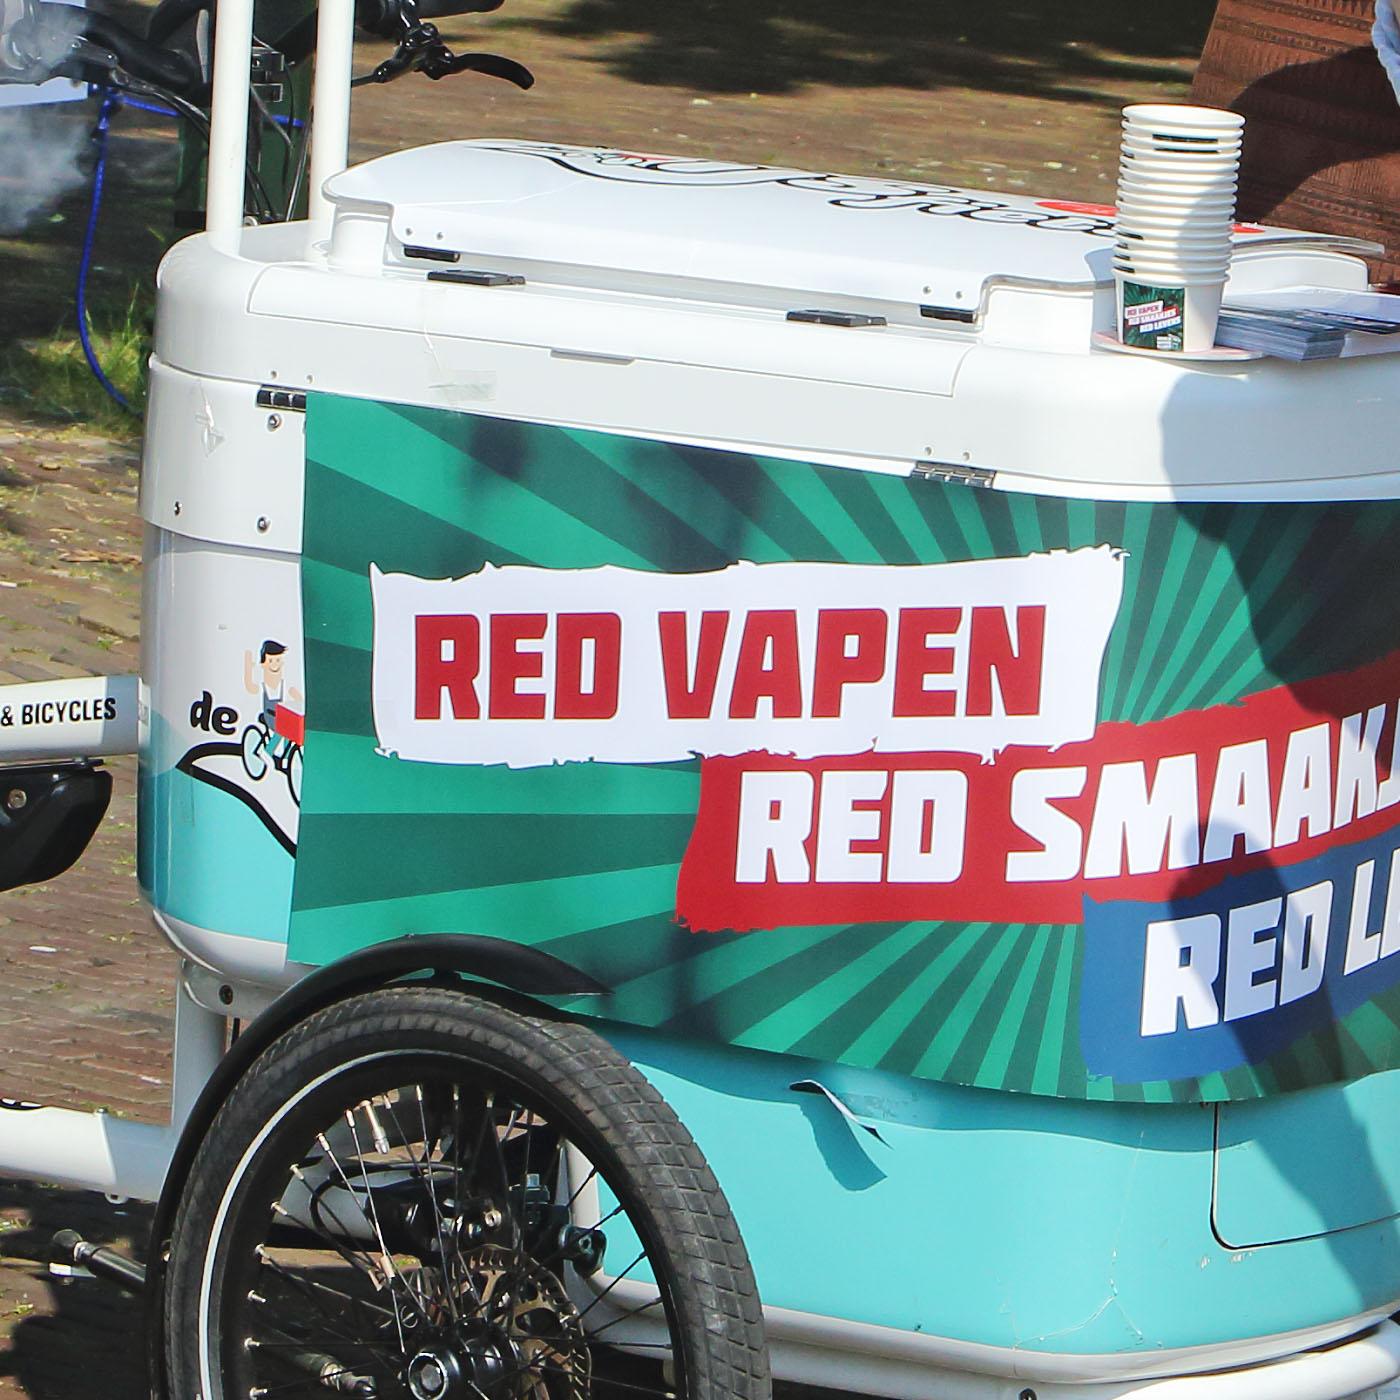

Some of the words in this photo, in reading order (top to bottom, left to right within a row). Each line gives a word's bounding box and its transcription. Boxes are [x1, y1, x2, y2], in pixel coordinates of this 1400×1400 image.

[0, 705, 14, 727] &
[21, 697, 117, 725] BICYCLES
[190, 690, 239, 736] de
[414, 611, 622, 720] RED
[657, 604, 1047, 720] VAPEN
[734, 768, 969, 884] RED
[1139, 879, 1335, 1038] RED
